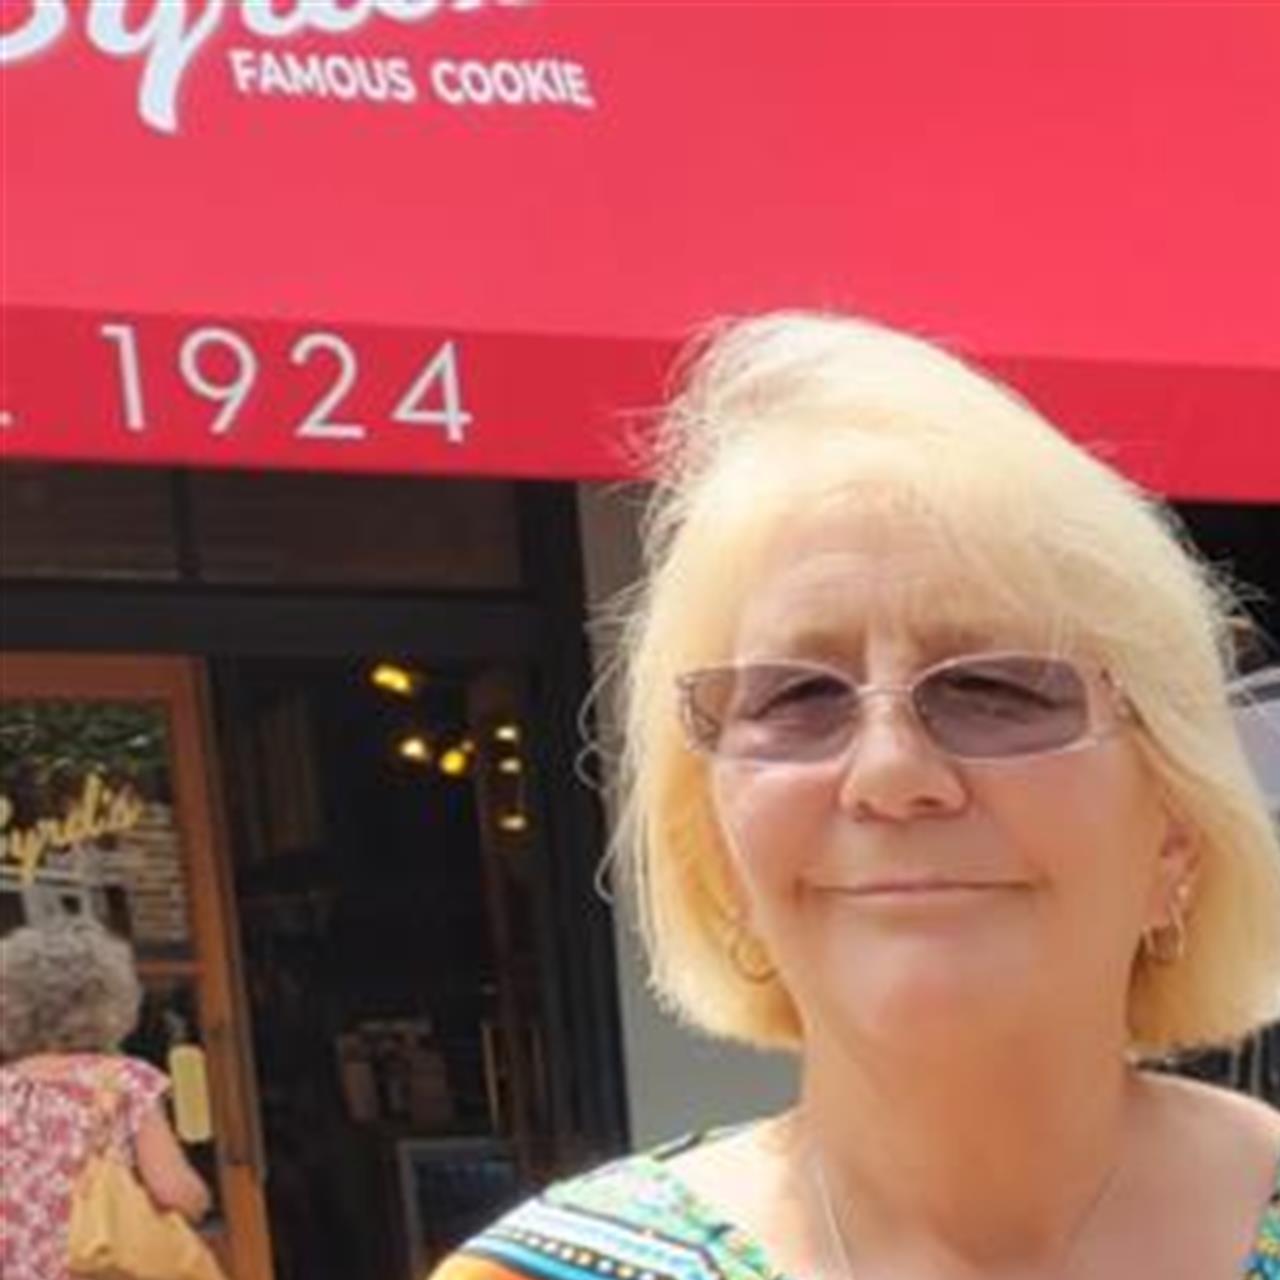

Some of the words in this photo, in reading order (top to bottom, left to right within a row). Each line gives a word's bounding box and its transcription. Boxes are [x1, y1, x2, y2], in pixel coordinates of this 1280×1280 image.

[230, 49, 416, 103] FAMOUS
[431, 59, 596, 108] COOKIE
[101, 323, 472, 443] 1924
